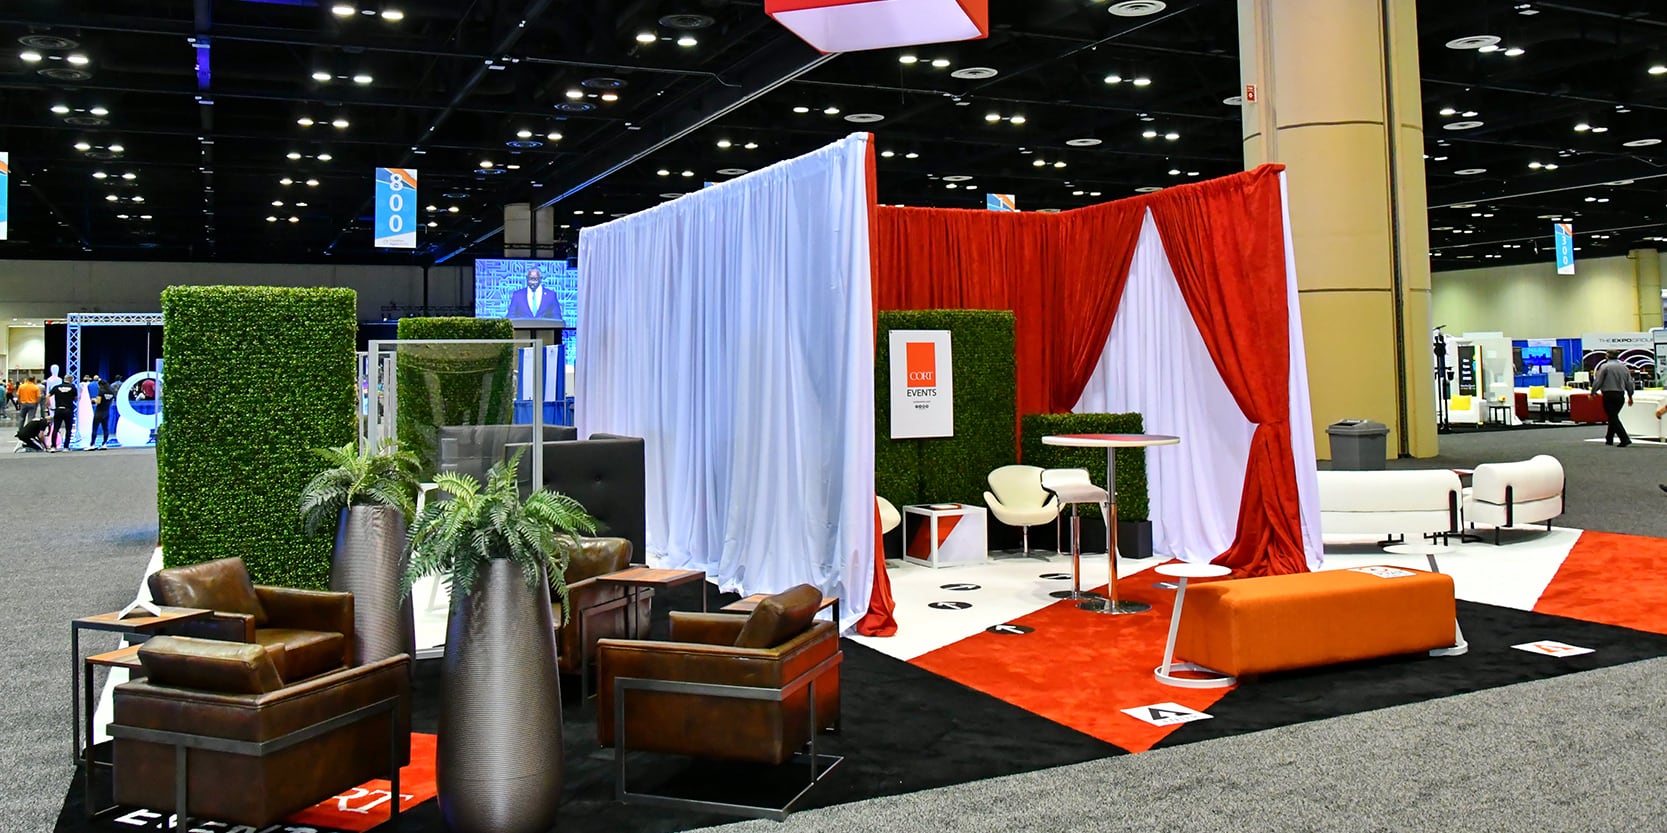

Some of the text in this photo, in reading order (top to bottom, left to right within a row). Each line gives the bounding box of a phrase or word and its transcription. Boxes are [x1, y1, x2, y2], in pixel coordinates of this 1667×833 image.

[389, 173, 403, 233] 800
[909, 371, 933, 380] CORT
[907, 389, 937, 397] EVENTS
